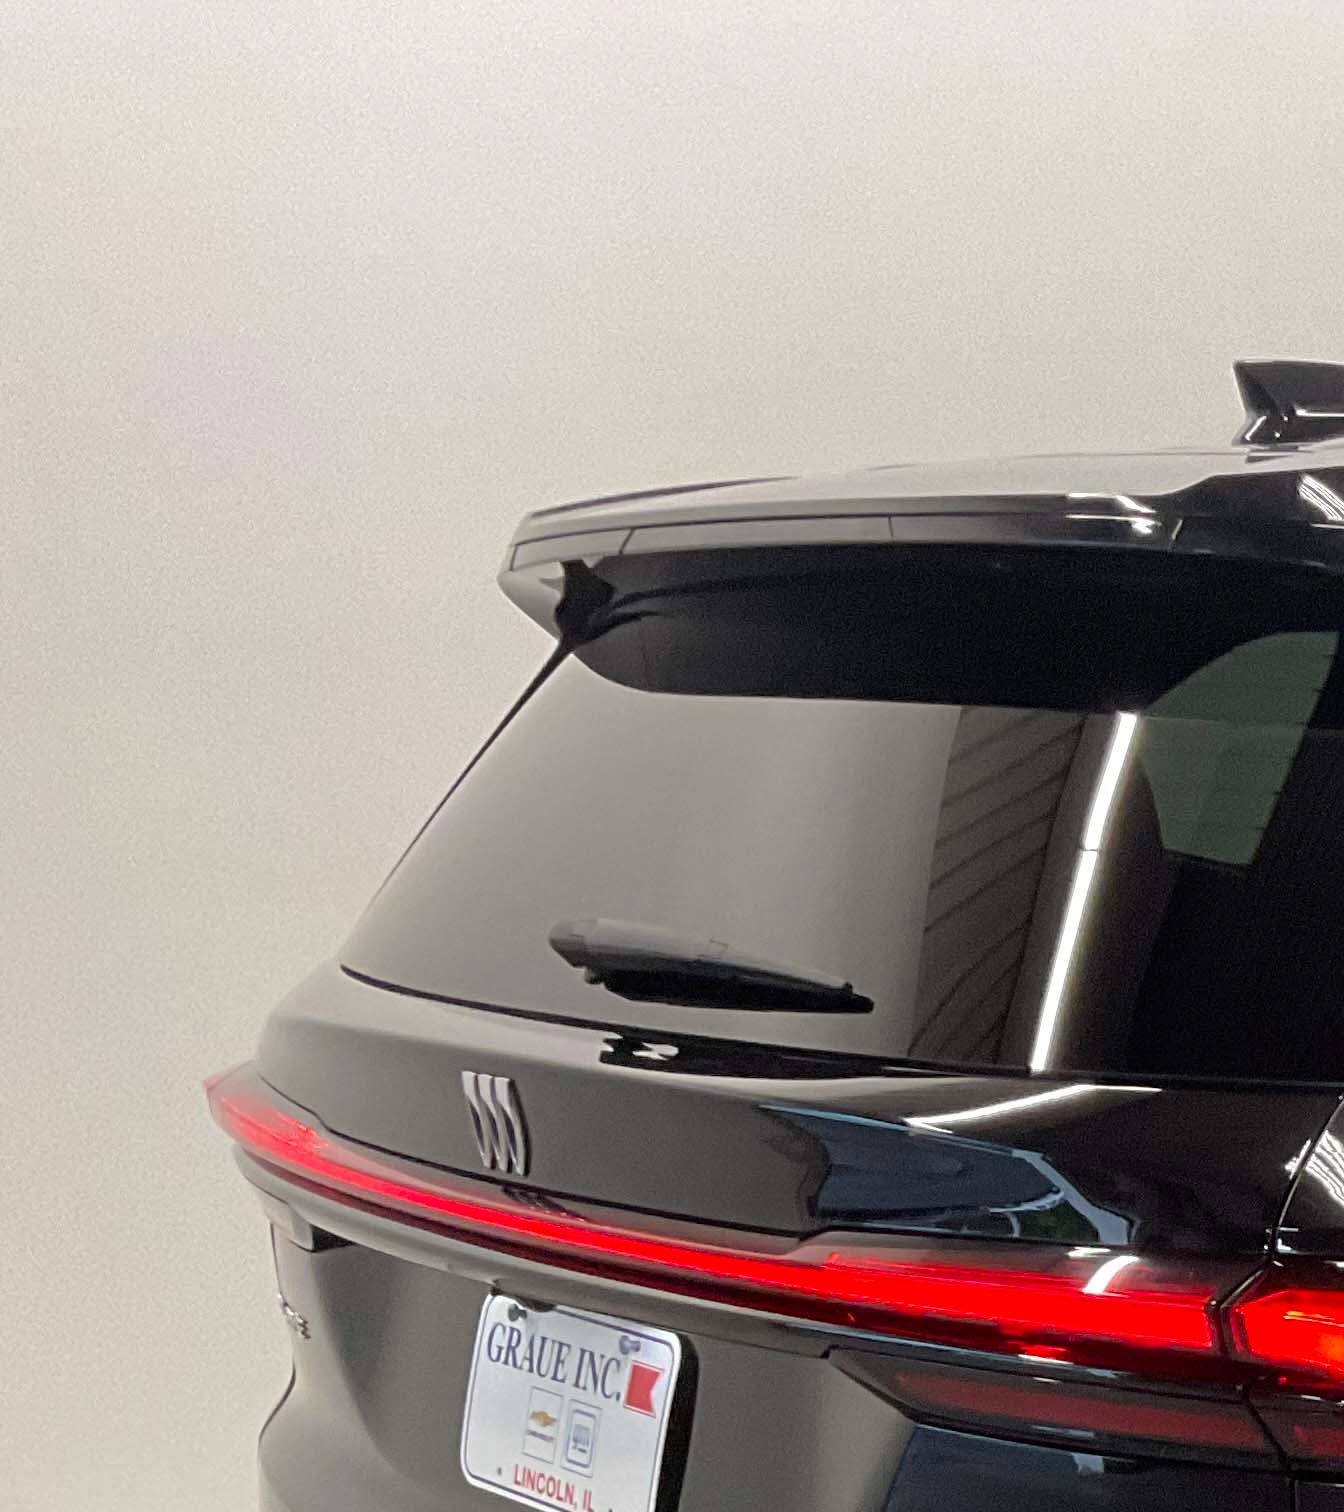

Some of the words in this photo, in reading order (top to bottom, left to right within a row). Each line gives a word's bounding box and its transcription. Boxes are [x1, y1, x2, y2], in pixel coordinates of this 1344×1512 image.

[487, 1322, 572, 1384] GRAUE
[574, 1347, 622, 1402] INC.
[513, 1463, 578, 1511] LINCOLN,
[582, 1489, 595, 1512] IL
